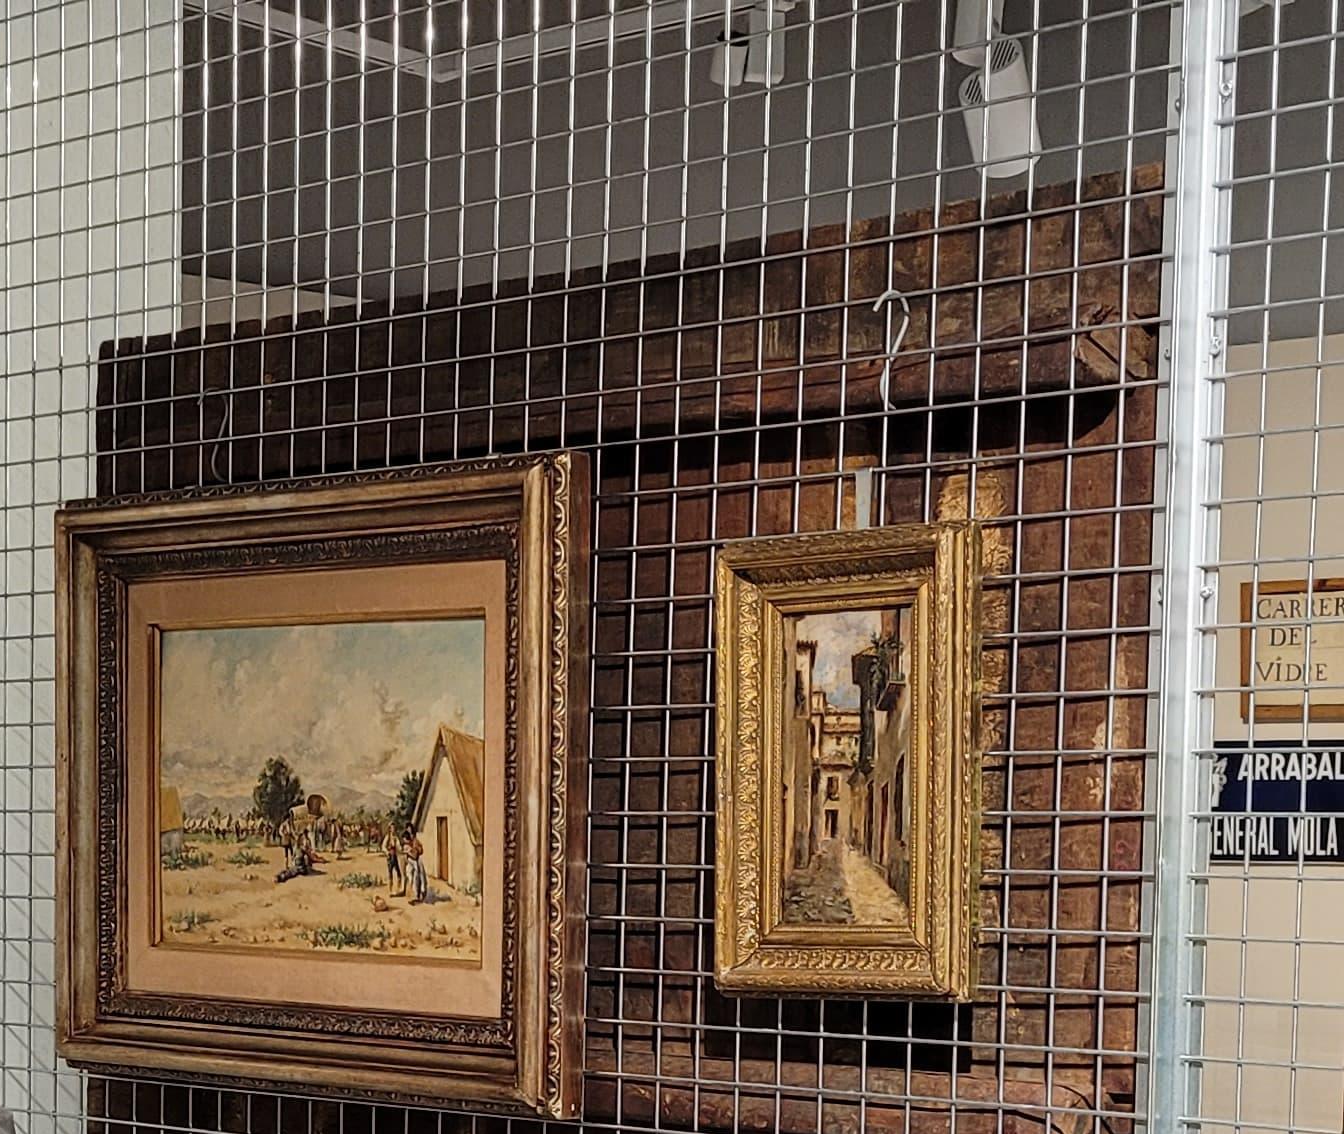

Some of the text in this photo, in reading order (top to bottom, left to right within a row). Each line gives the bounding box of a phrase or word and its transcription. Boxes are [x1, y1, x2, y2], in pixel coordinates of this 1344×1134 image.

[1256, 656, 1328, 682] VÍDE
[1210, 816, 1338, 856] ENERAL MOLA
